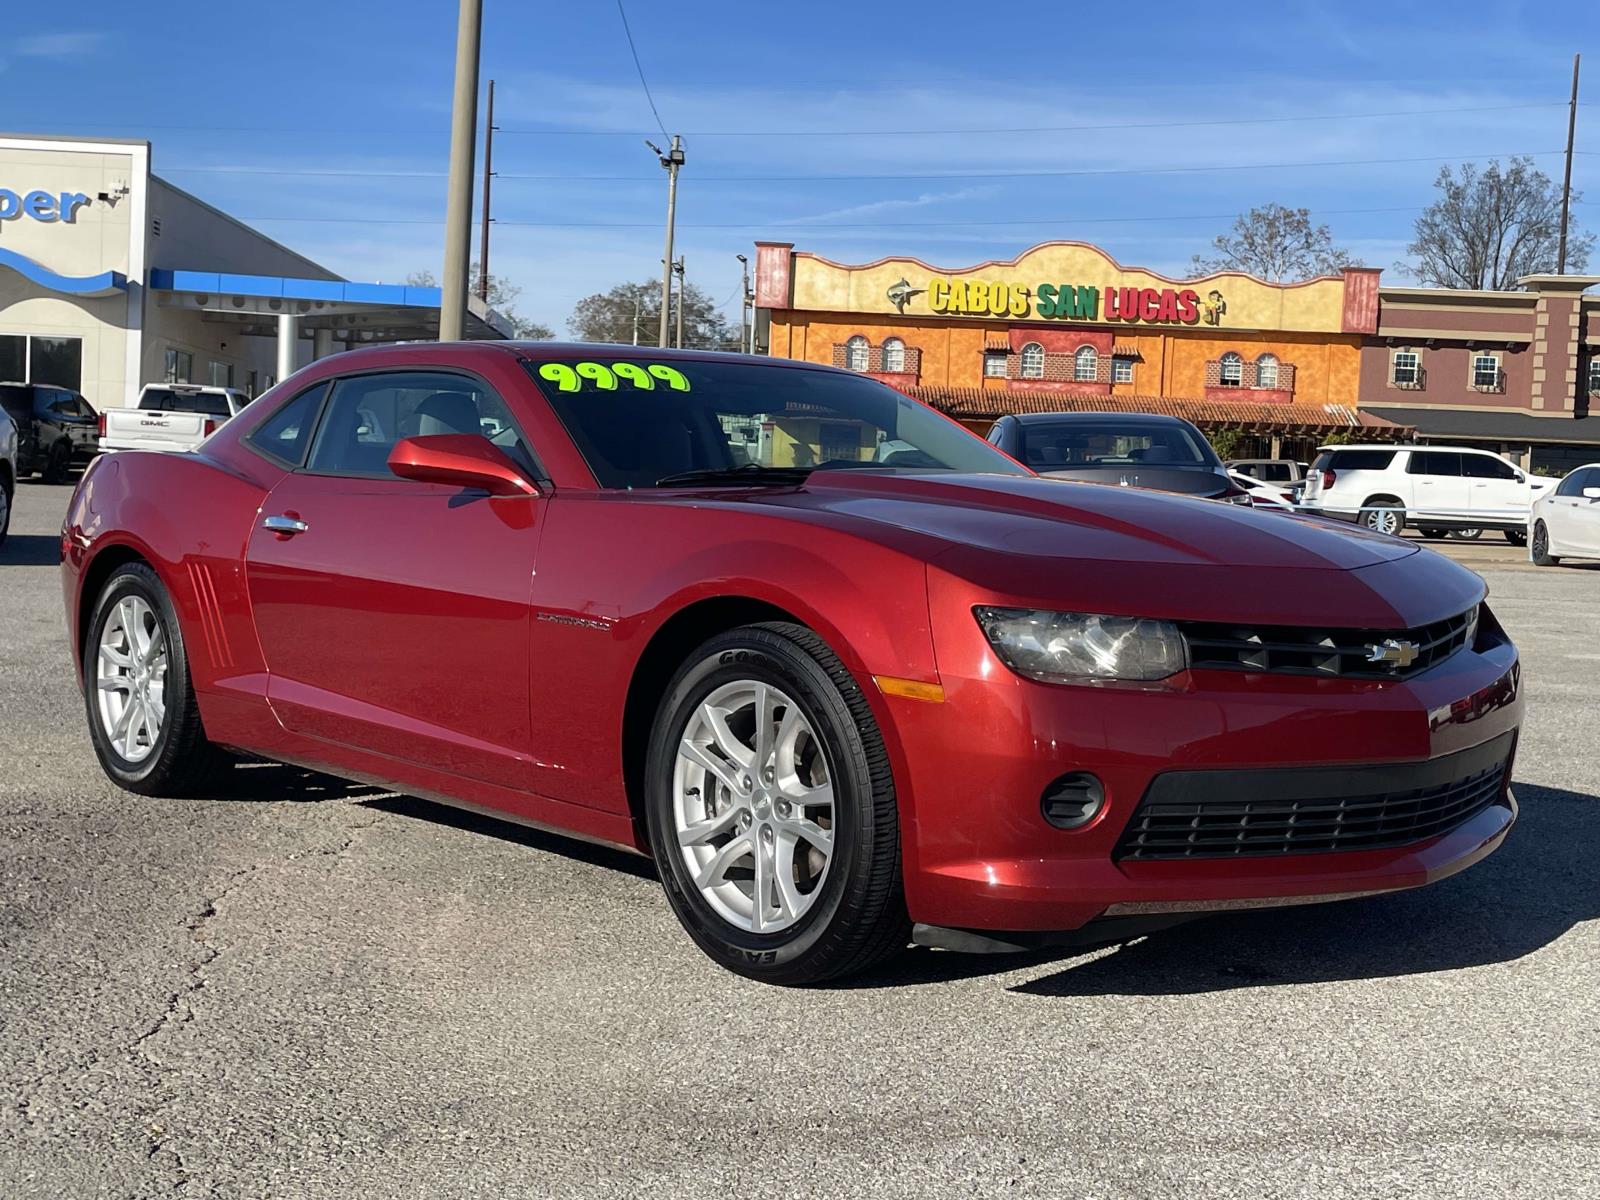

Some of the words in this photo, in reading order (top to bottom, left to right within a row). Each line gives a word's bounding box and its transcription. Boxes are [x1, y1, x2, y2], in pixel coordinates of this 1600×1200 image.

[928, 278, 1029, 317] CABOS
[1036, 283, 1098, 320] SAN
[1104, 286, 1199, 325] LUCAS
[538, 362, 691, 392] 9999
[140, 419, 170, 428] GMC
